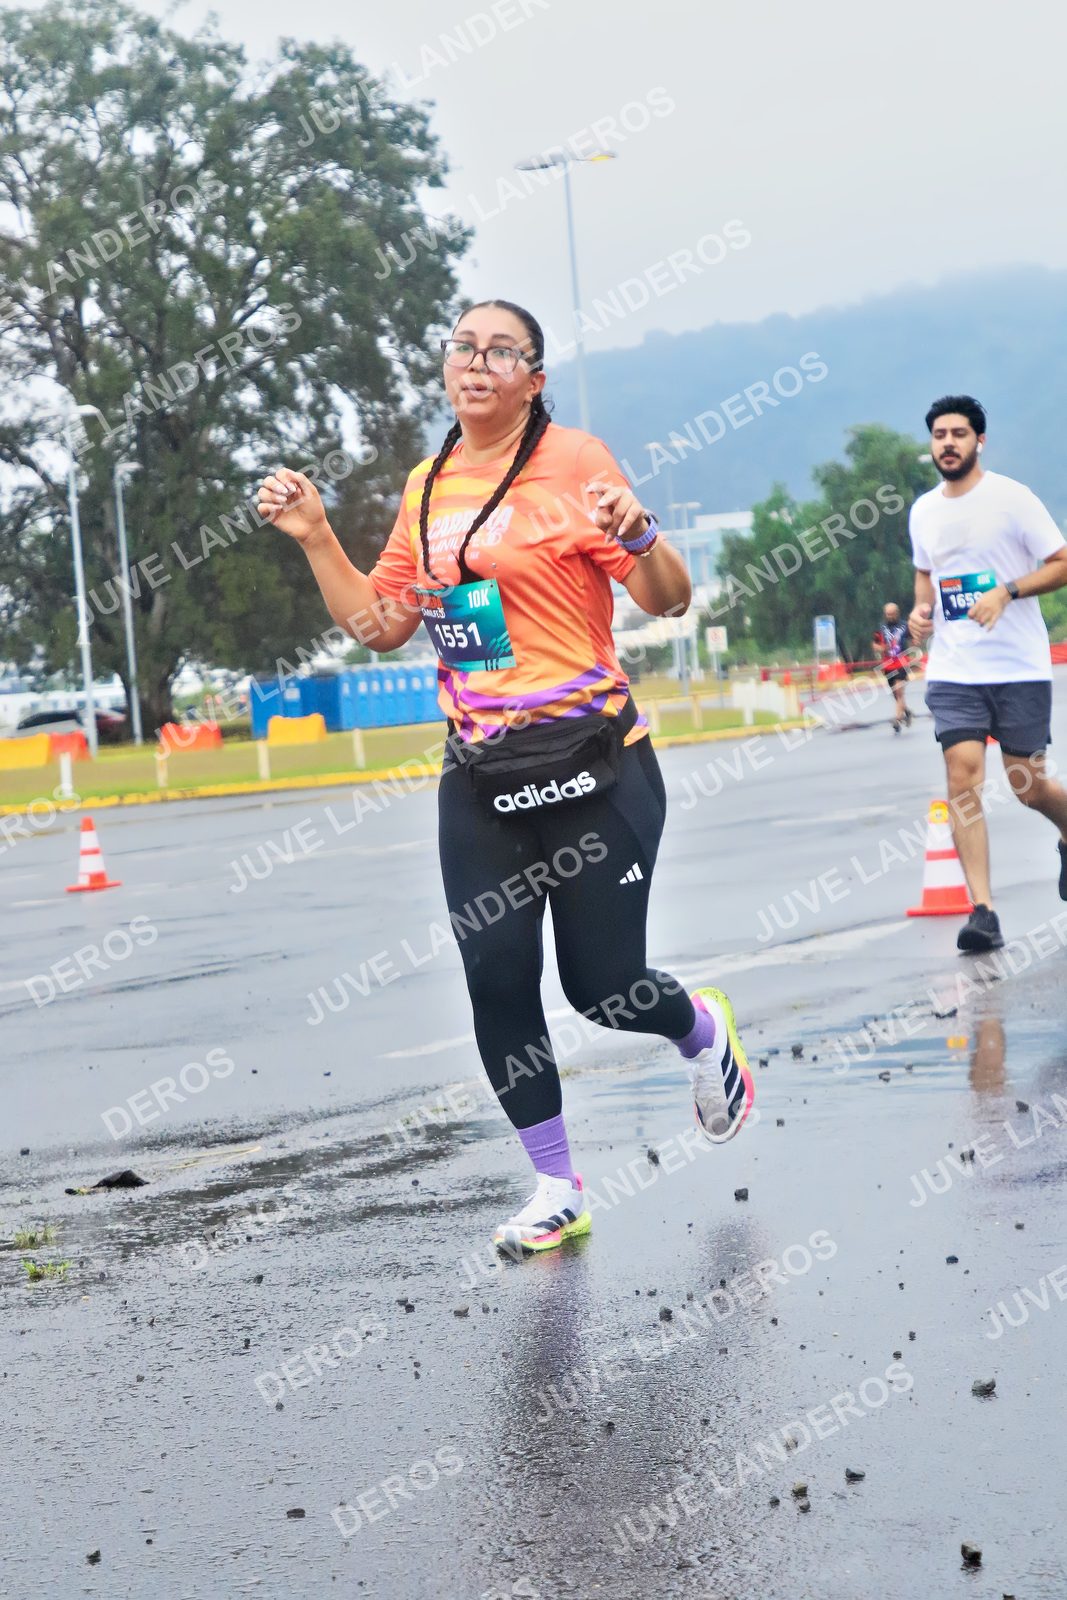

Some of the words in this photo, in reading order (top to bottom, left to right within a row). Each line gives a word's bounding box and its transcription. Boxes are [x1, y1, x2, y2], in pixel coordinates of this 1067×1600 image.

[467, 587, 490, 609] 10K
[434, 622, 482, 648] 1551
[493, 771, 598, 813] adidas
